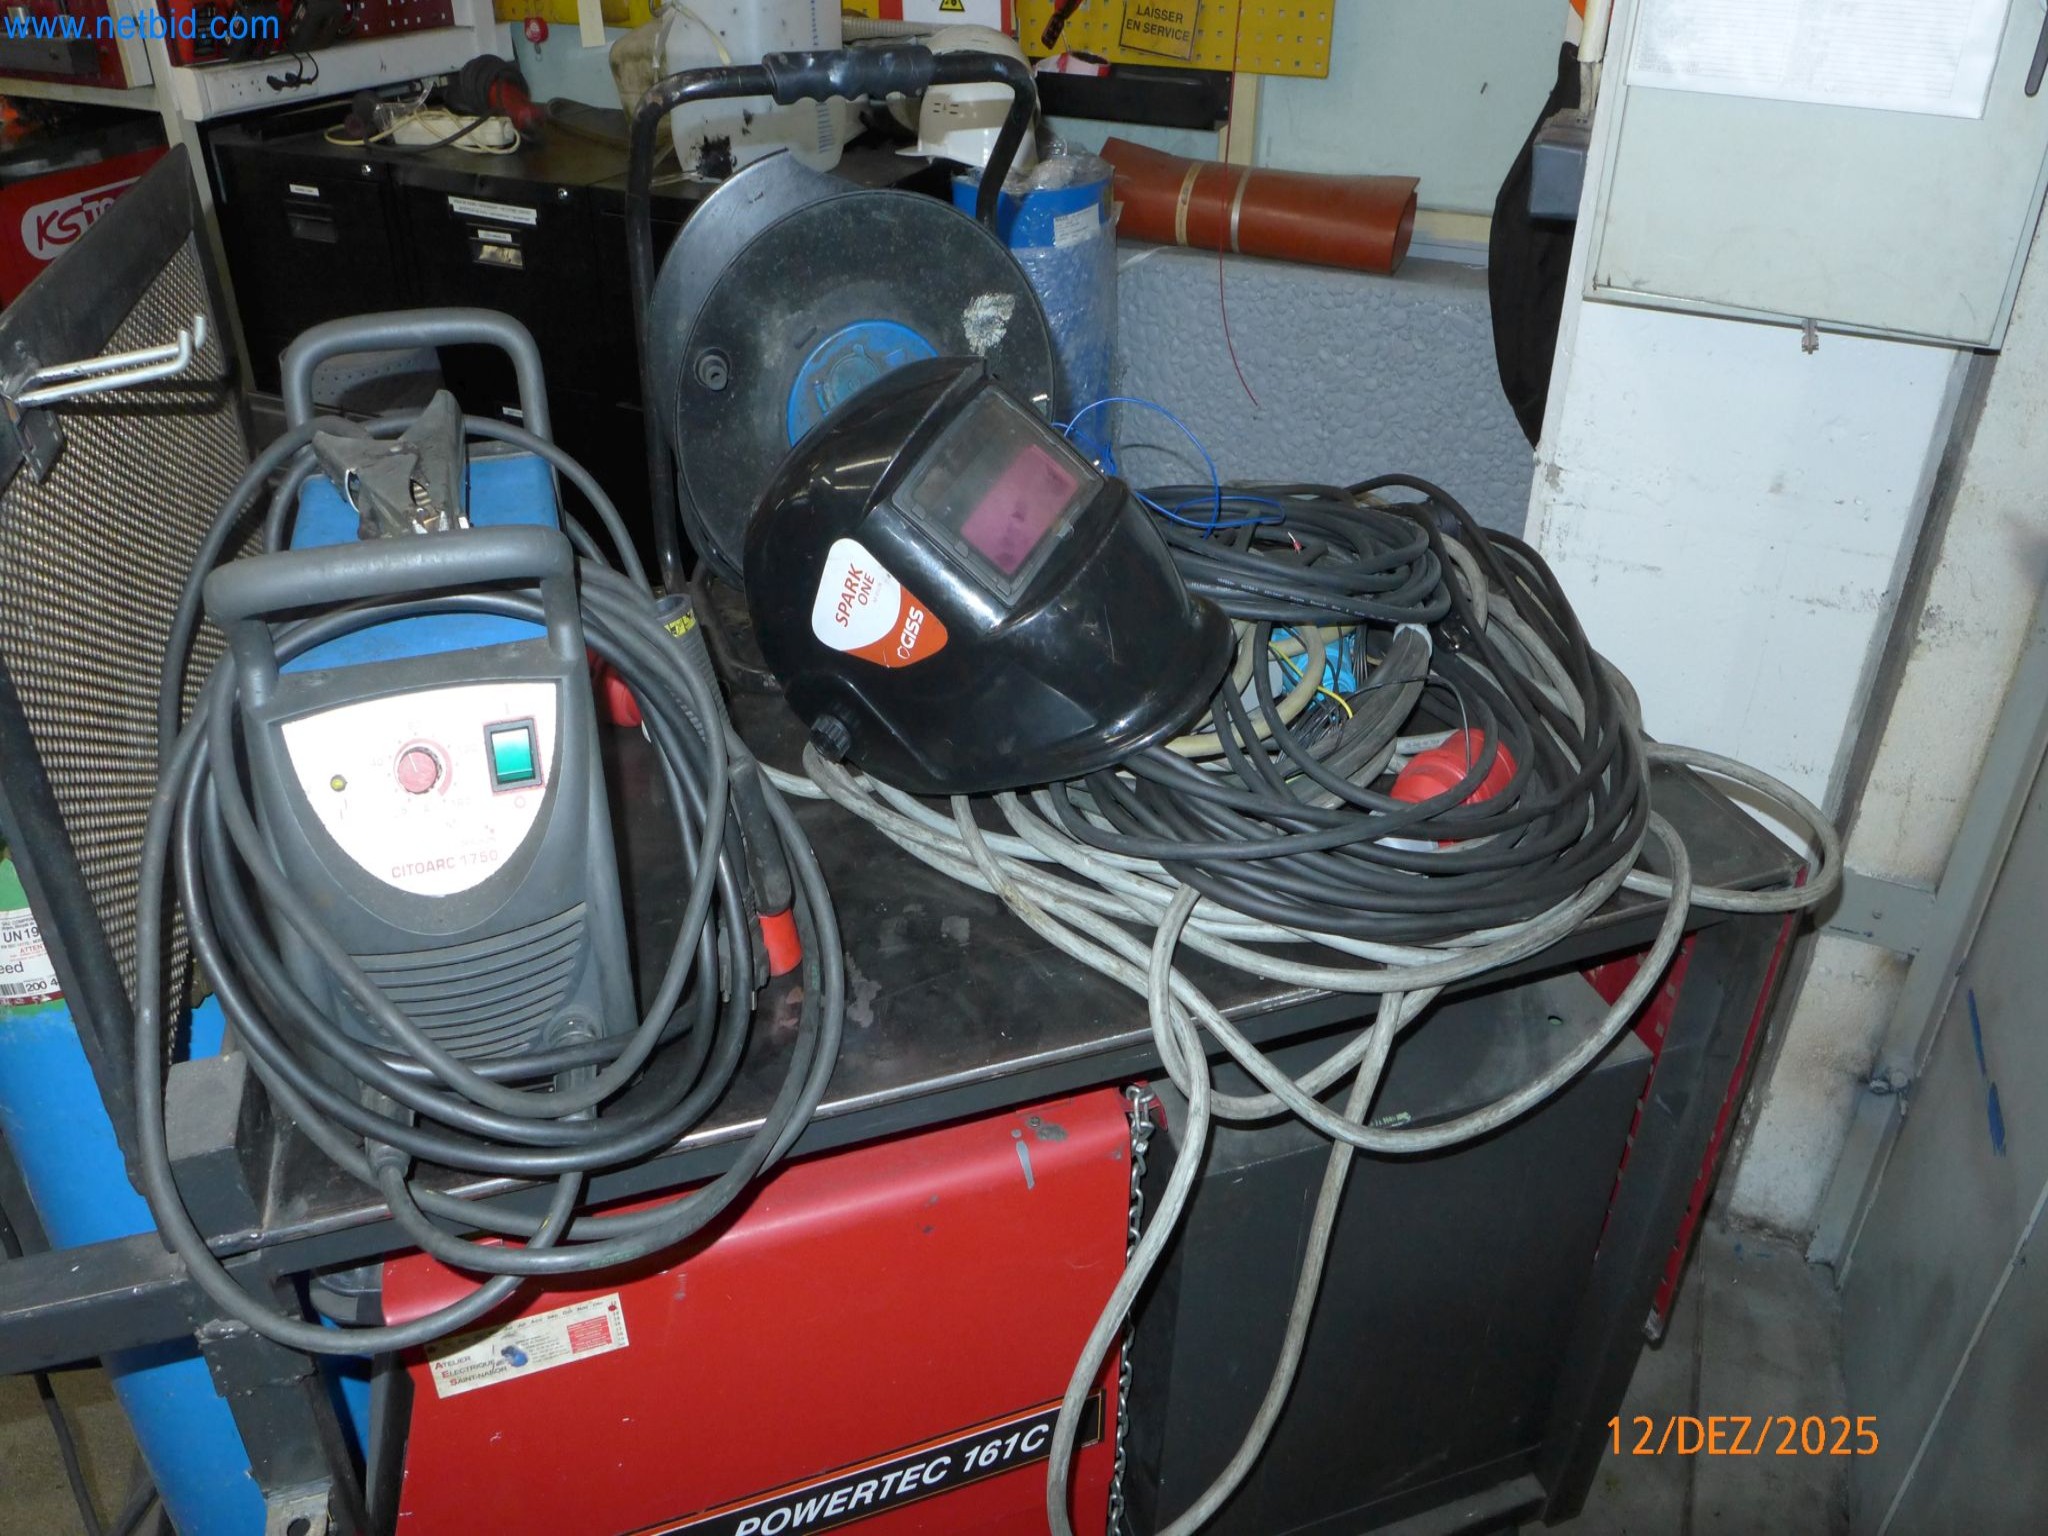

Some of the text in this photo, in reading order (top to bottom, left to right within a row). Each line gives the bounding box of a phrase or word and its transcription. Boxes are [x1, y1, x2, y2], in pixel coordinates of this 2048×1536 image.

[1136, 4, 1184, 24] LAISSER
[1126, 18, 1190, 41] EN SERVICE
[835, 563, 863, 628] SPARK
[857, 573, 875, 606] ONE
[900, 606, 924, 649] GISS
[391, 849, 498, 878] CITOARC 1750
[3, 930, 23, 943] UN
[25, 980, 48, 992] 200
[435, 1356, 471, 1370] ATELIER
[735, 1424, 1050, 1536] POWERTEC 161C
